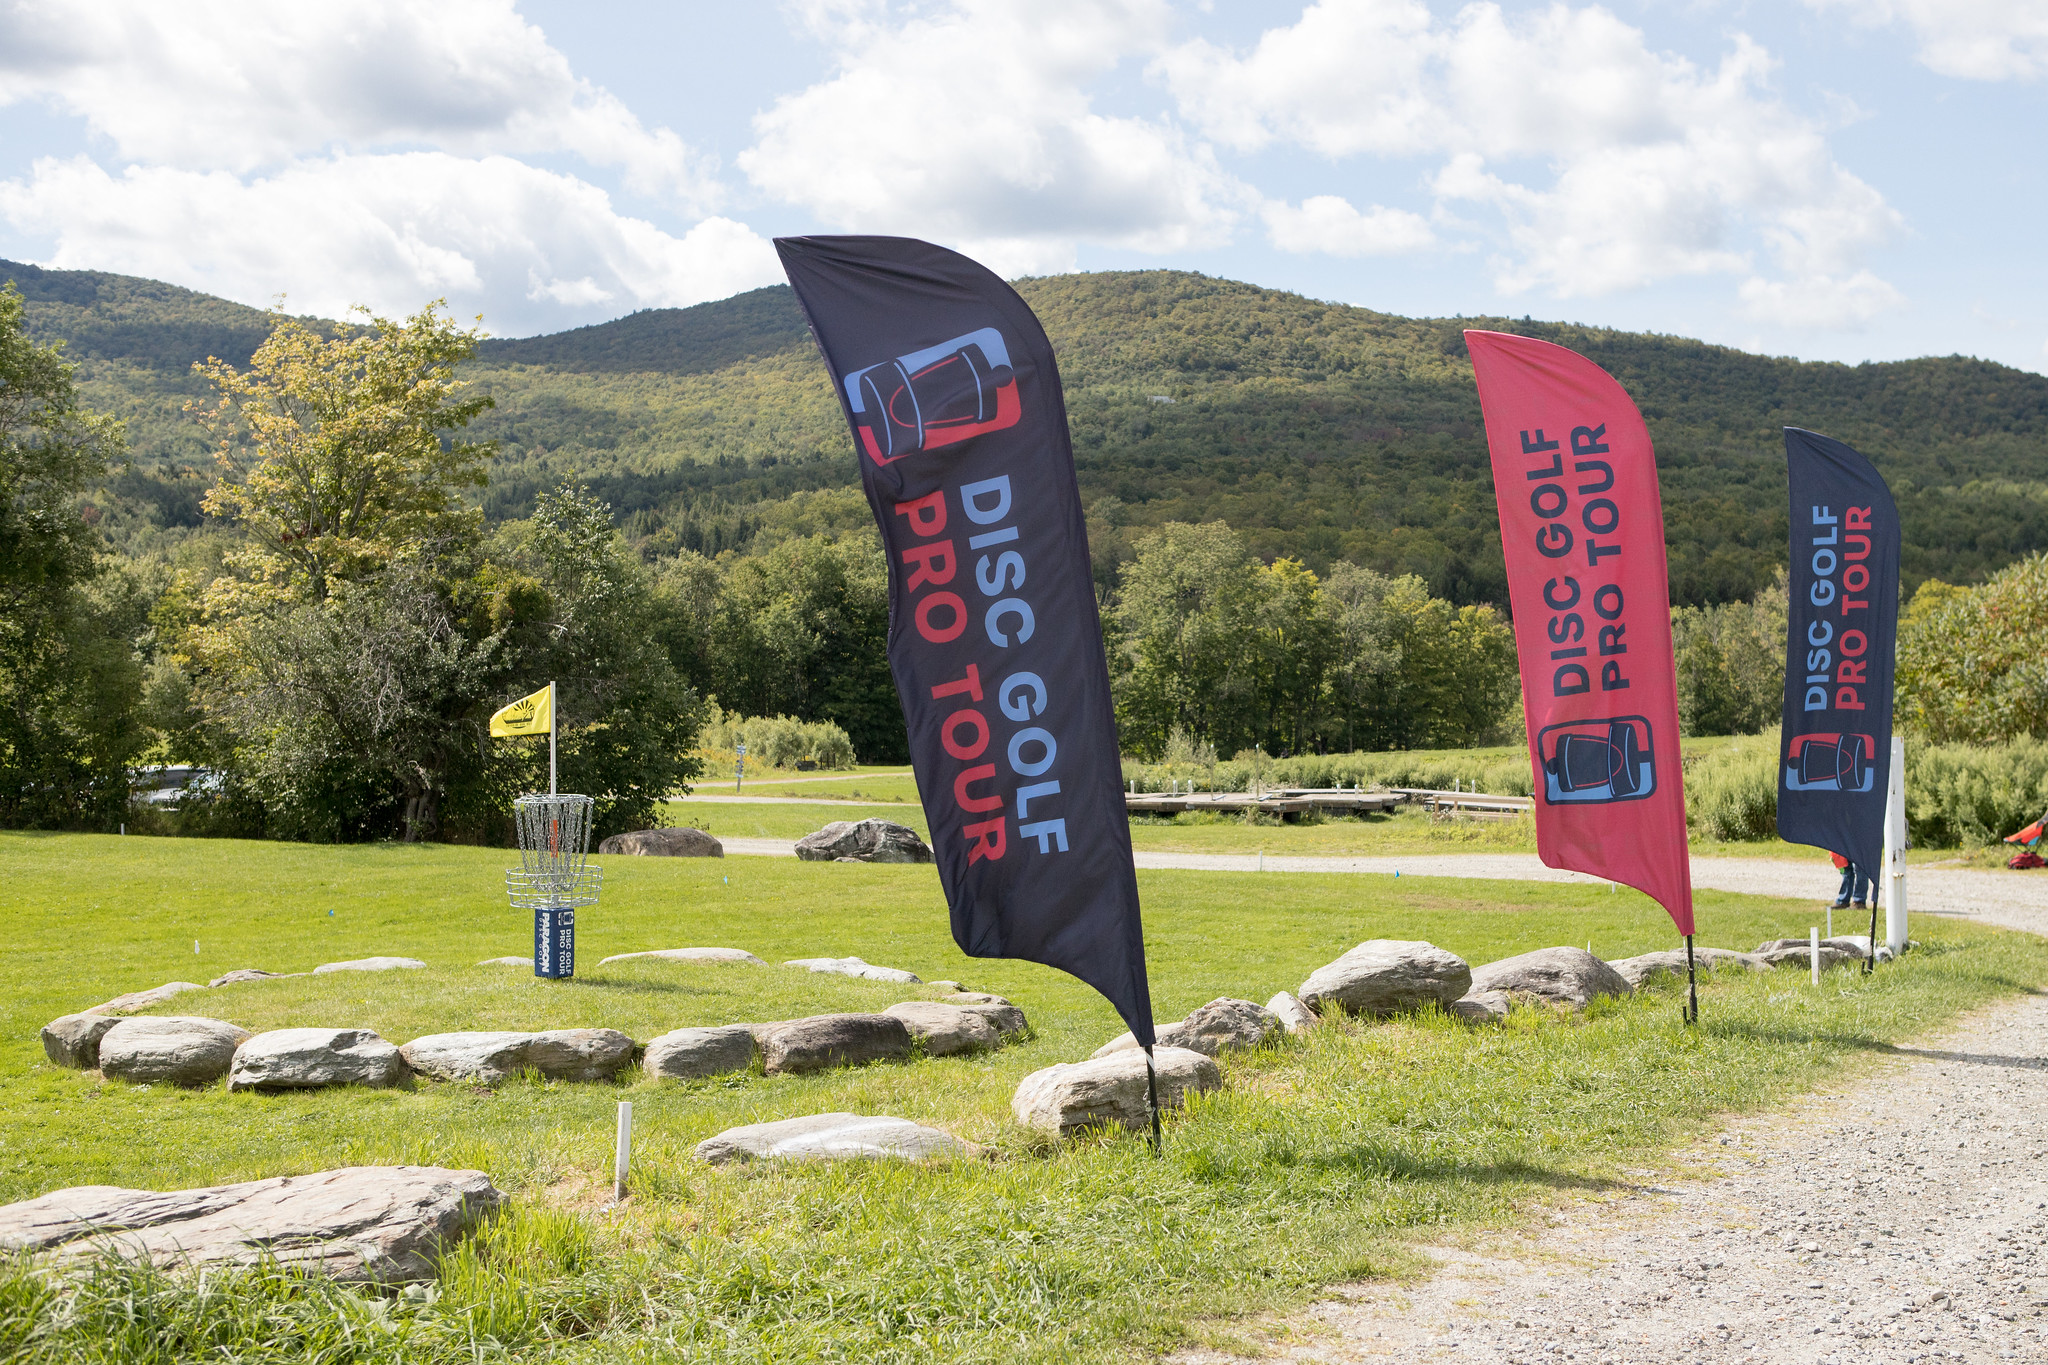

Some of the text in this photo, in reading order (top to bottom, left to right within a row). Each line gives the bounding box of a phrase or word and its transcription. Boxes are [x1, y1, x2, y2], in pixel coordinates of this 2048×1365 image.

[894, 489, 1008, 867] PRO TOUR
[959, 473, 1070, 854] DISC GOLF
[1520, 429, 1591, 697] DISC GOLF
[1570, 422, 1631, 692] PRO TOUR
[1804, 506, 1837, 712] DISC GOLF
[1835, 506, 1872, 710] PRO TOUR
[541, 912, 550, 973] PARAGON
